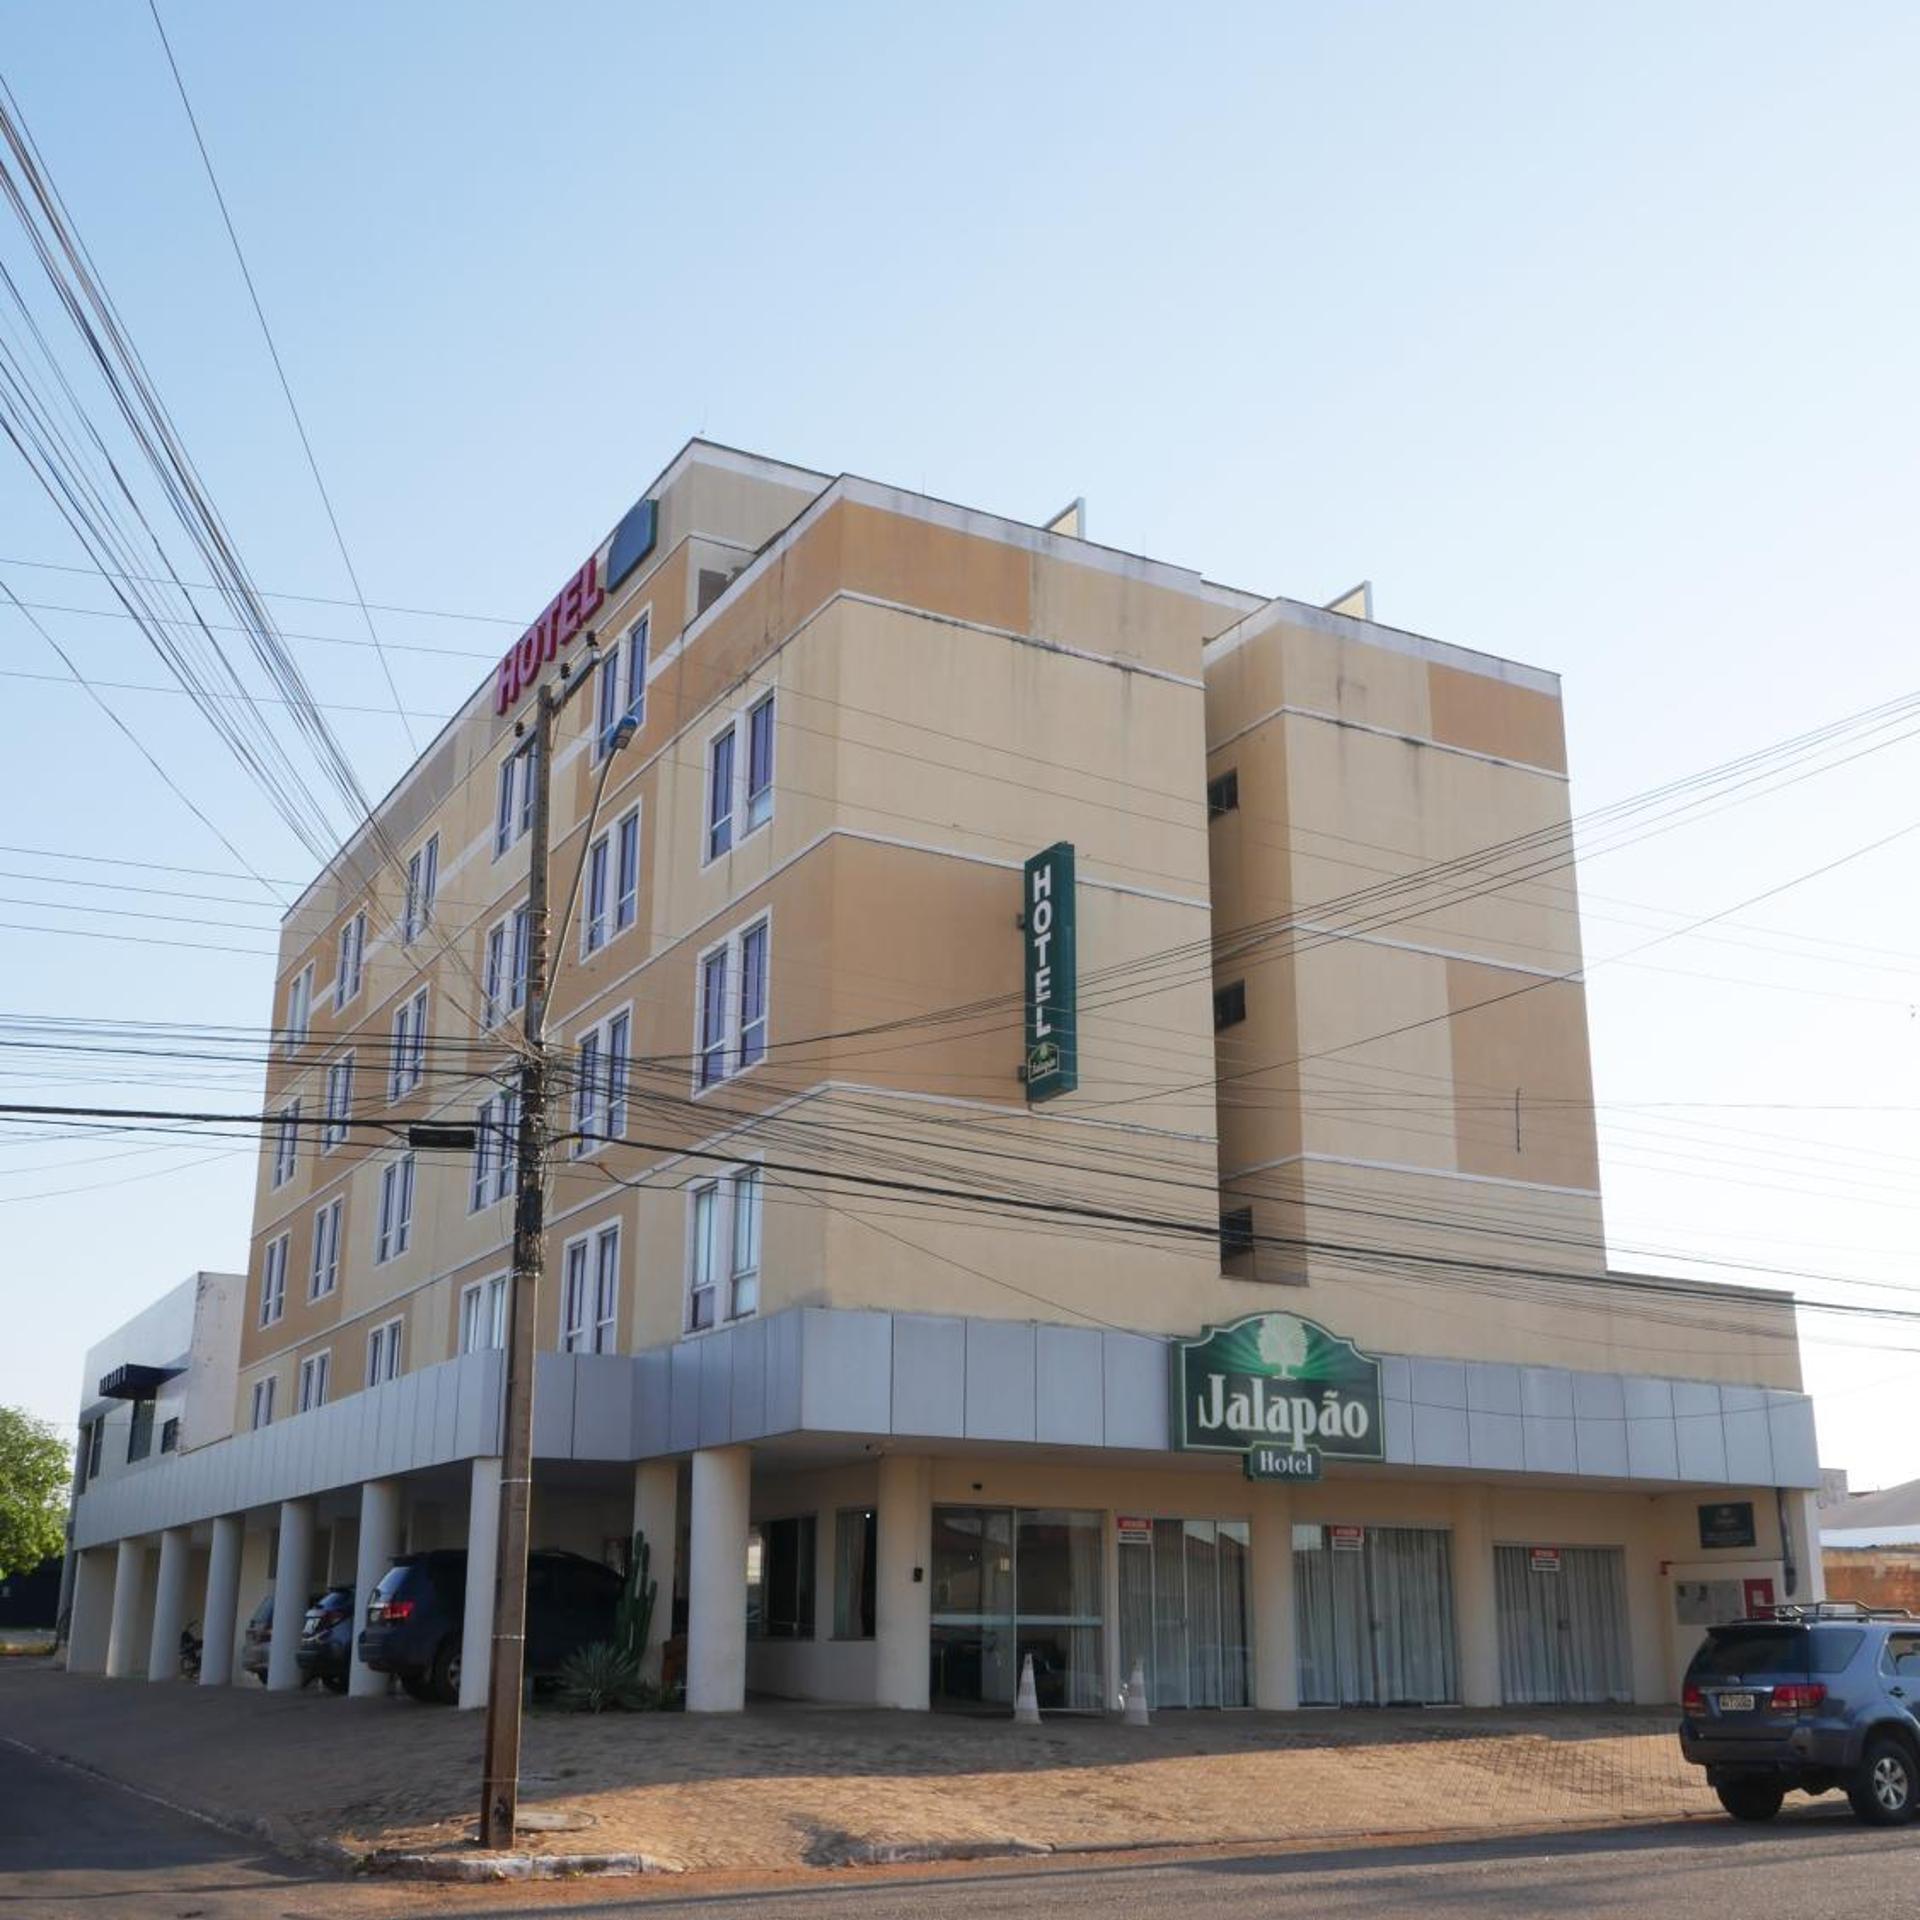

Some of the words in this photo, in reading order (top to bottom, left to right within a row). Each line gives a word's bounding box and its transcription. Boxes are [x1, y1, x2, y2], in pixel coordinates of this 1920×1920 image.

[496, 555, 604, 715] HOTEL
[1032, 864, 1053, 1038] HOTEL
[1198, 1373, 1369, 1451] Jalapão
[1260, 1450, 1313, 1475] Hotel
